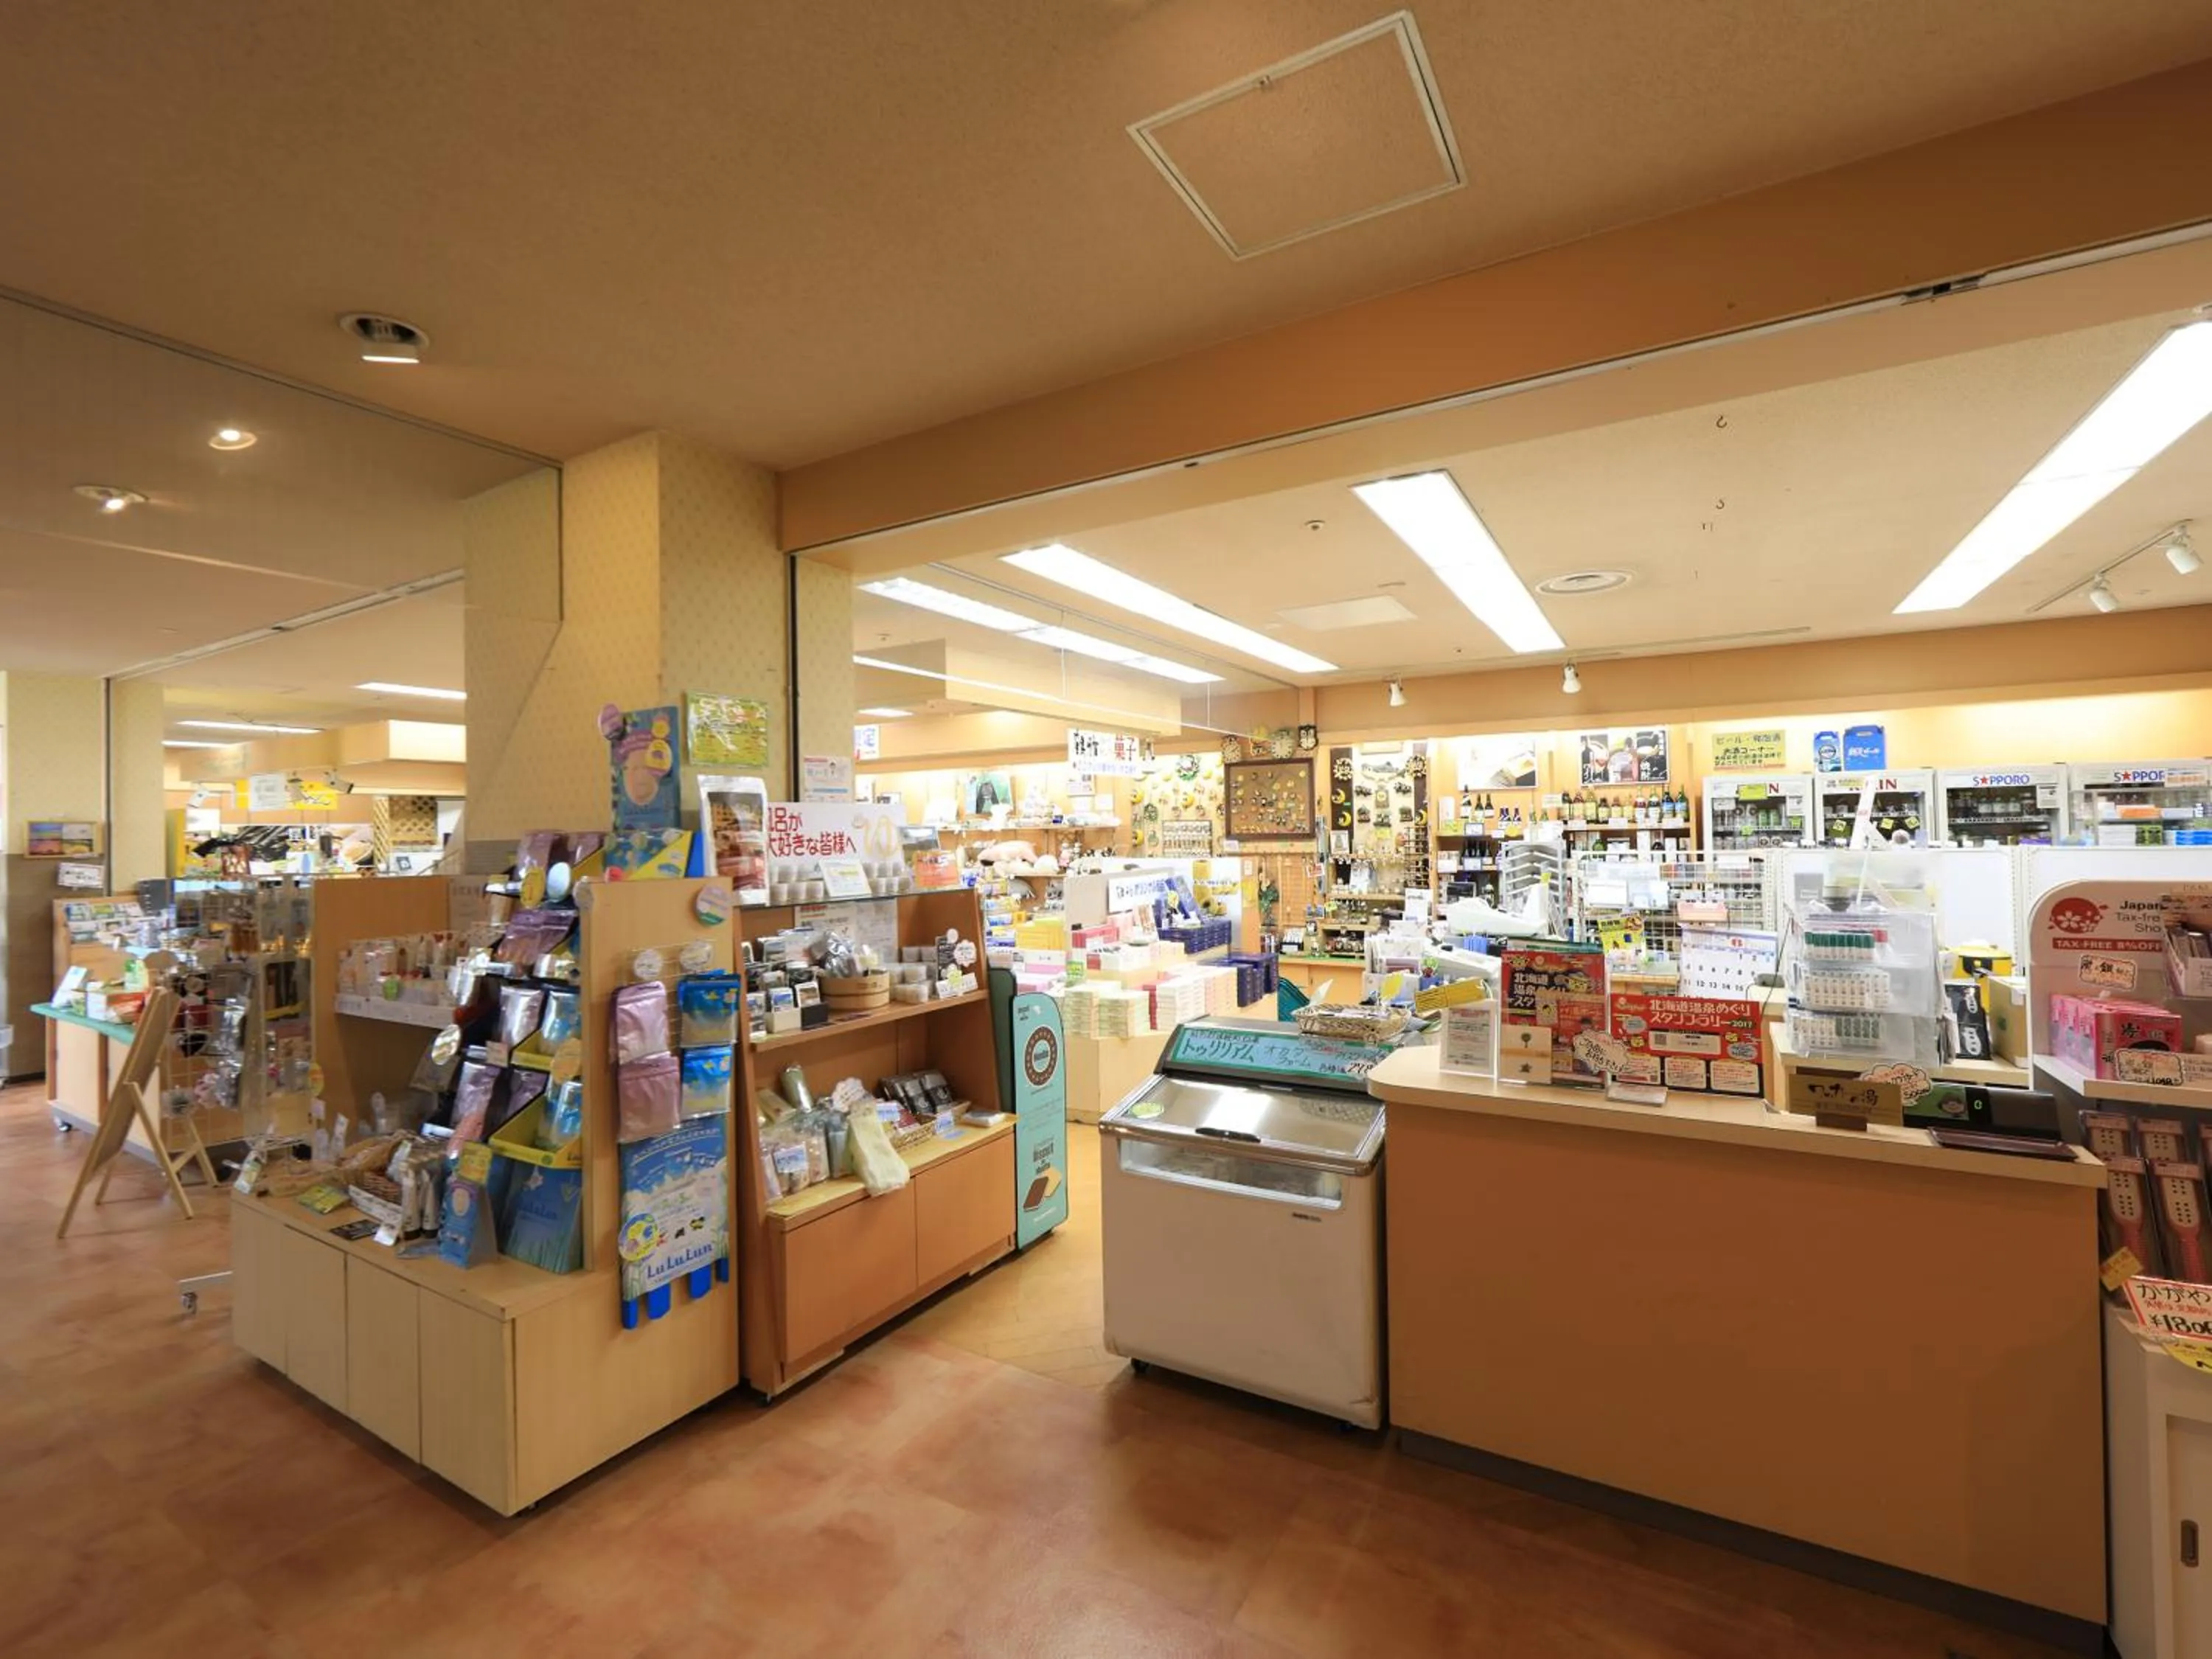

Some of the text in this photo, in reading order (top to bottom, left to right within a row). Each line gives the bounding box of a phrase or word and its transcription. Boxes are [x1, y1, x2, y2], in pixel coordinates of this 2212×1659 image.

[2116, 912, 2160, 922] Tax-fre
[2135, 922, 2161, 933] Sho
[1649, 999, 1750, 1017] 北海道温泉めぐり
